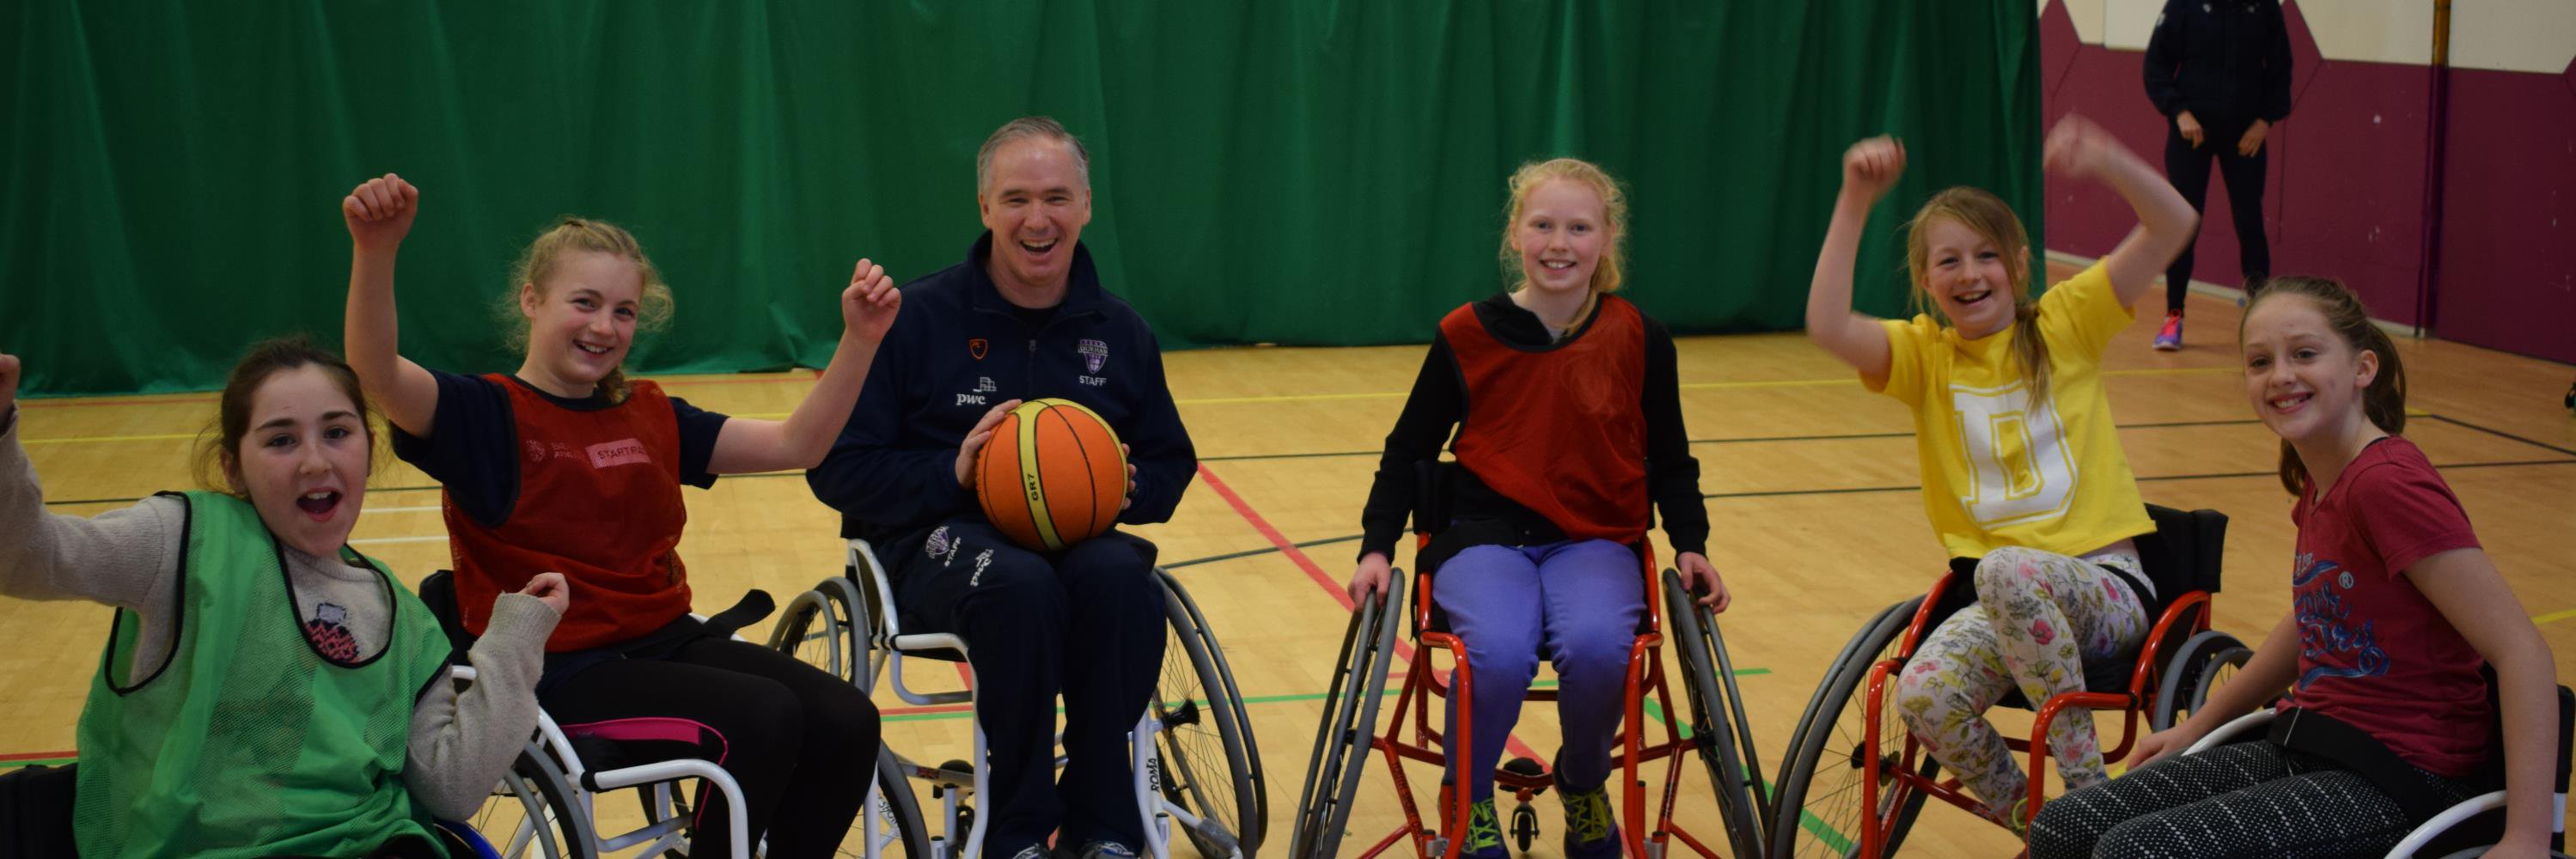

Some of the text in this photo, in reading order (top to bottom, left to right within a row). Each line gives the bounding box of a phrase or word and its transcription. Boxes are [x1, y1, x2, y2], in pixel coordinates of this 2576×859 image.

[1078, 375, 1108, 387] STAFF
[955, 393, 986, 405] pwc
[1948, 379, 2079, 531] D
[1027, 473, 1039, 502] GR7
[1146, 758, 1161, 793] ROMA
